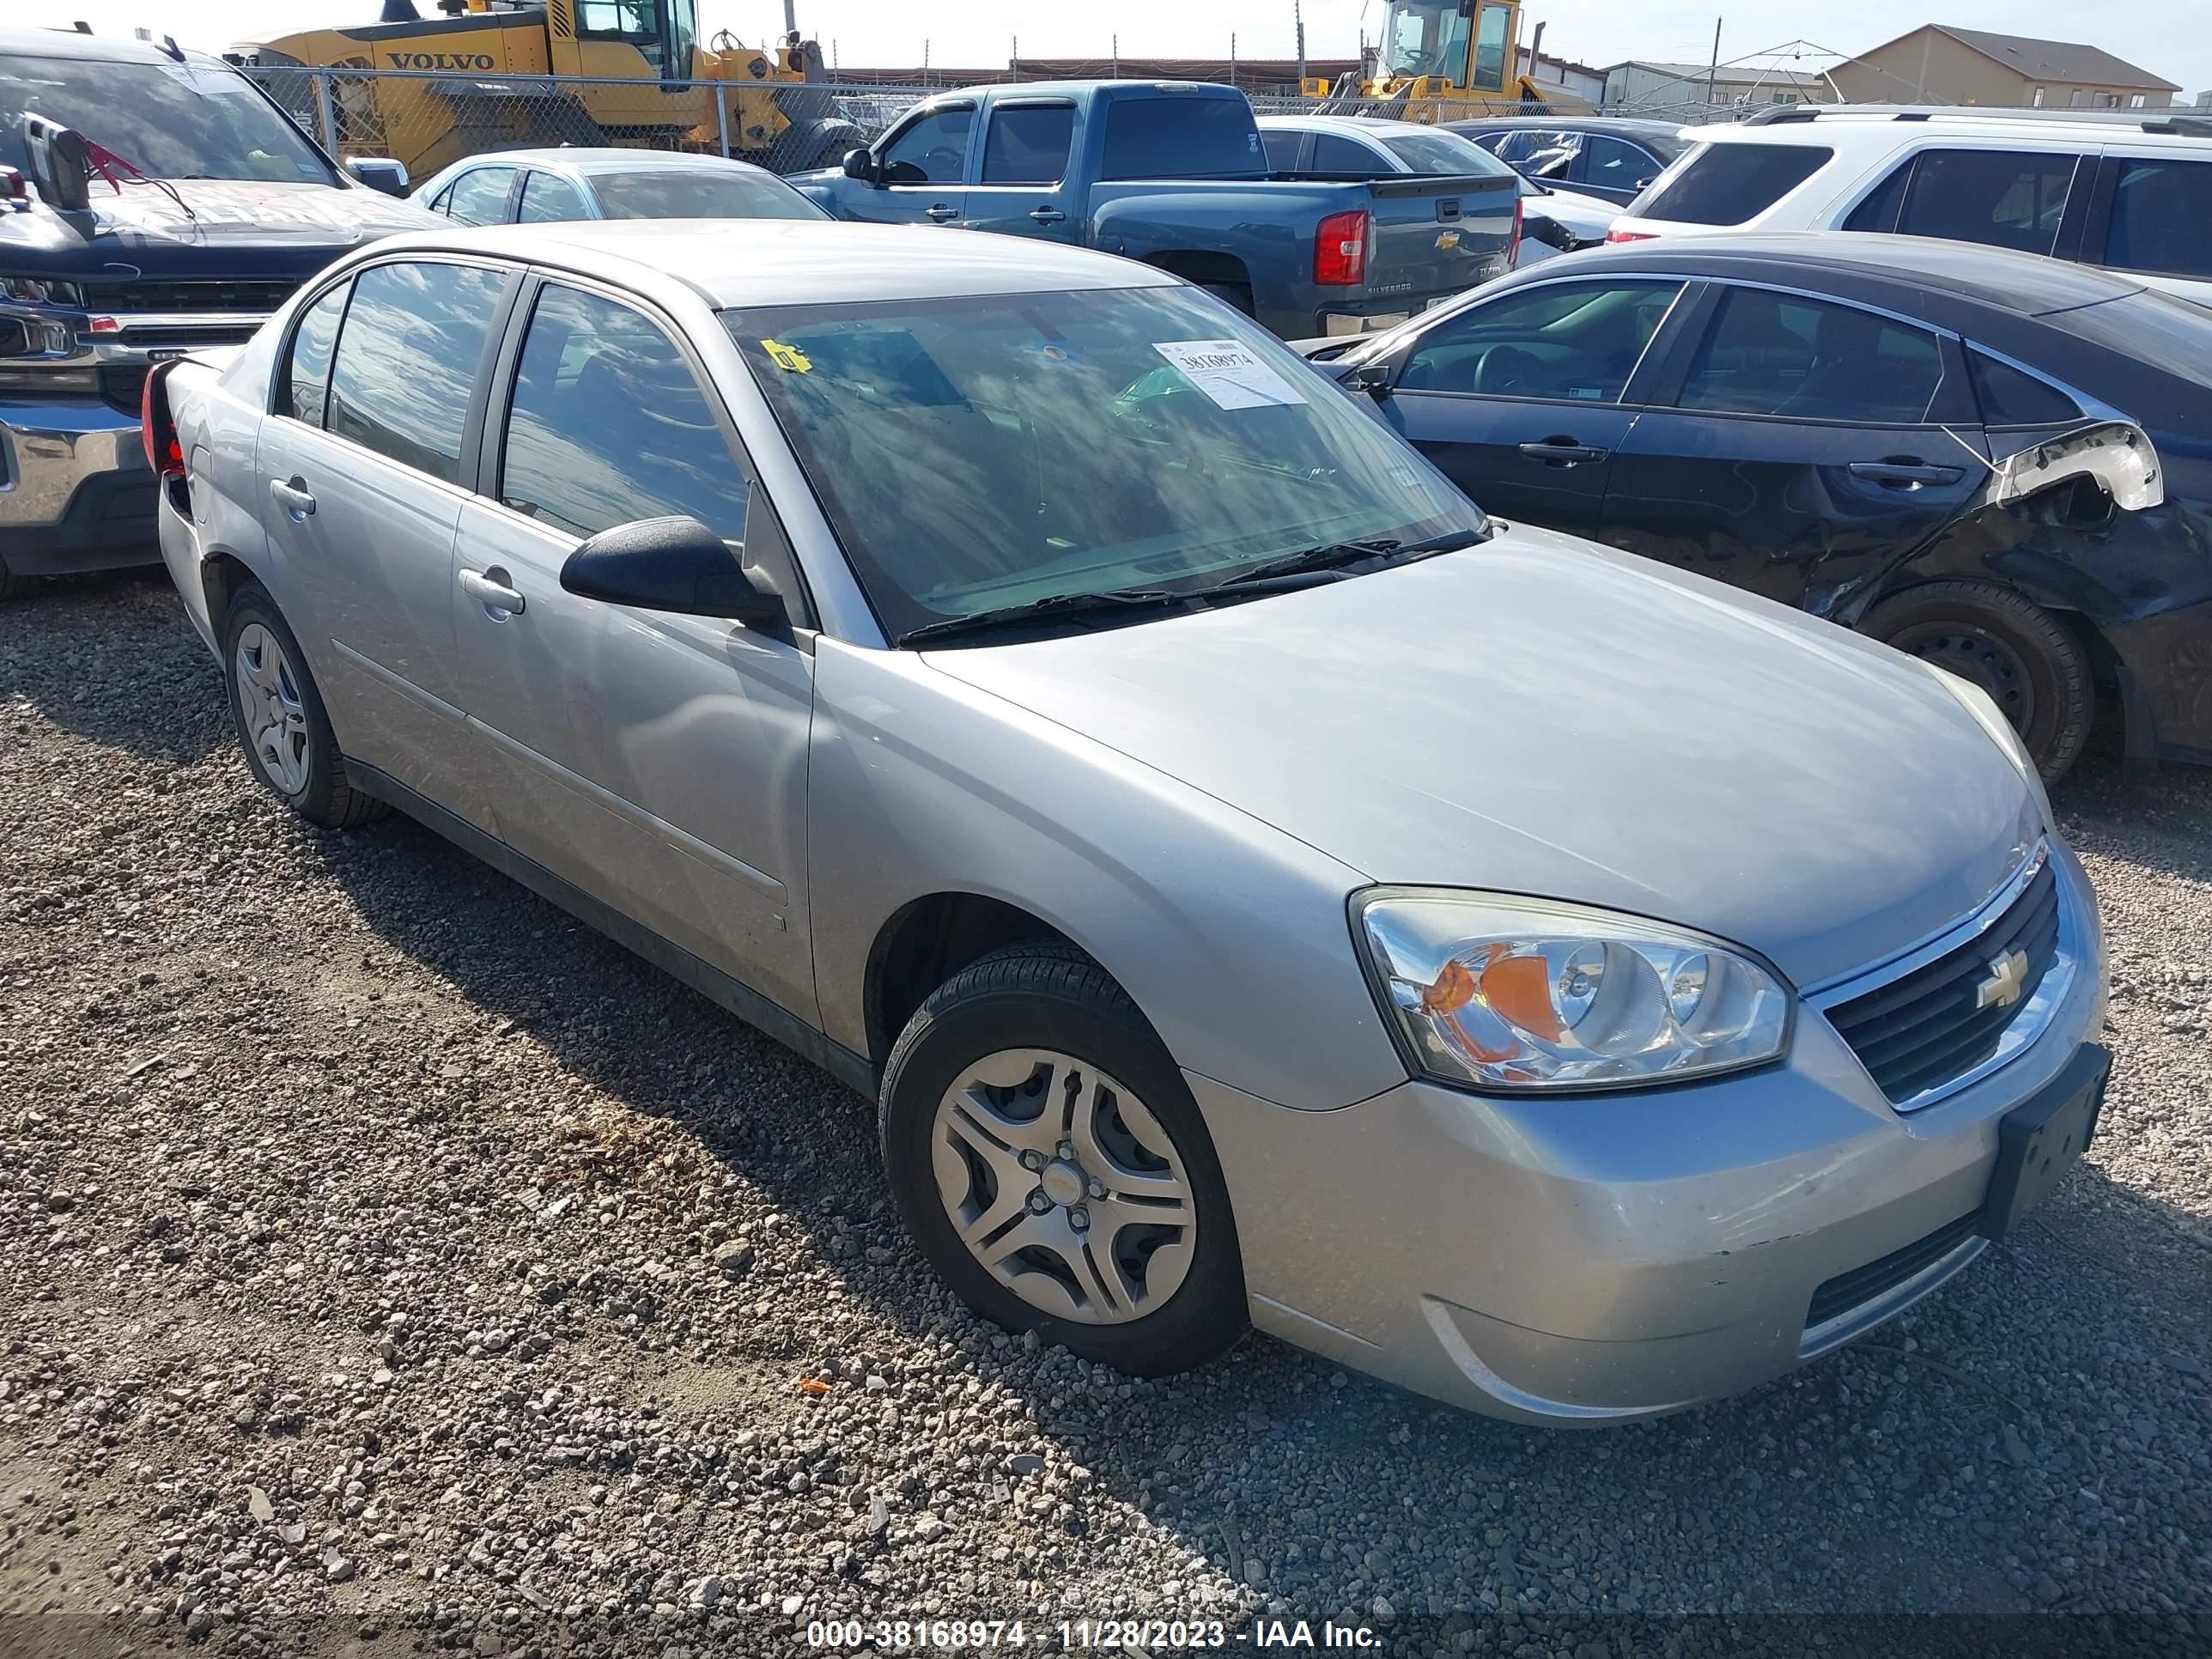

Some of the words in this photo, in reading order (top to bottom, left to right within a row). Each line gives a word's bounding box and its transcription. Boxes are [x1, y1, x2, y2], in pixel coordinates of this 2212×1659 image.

[386, 52, 495, 70] VOLVO
[1368, 283, 1412, 295] SILVERADO
[1179, 354, 1255, 370] 38168974
